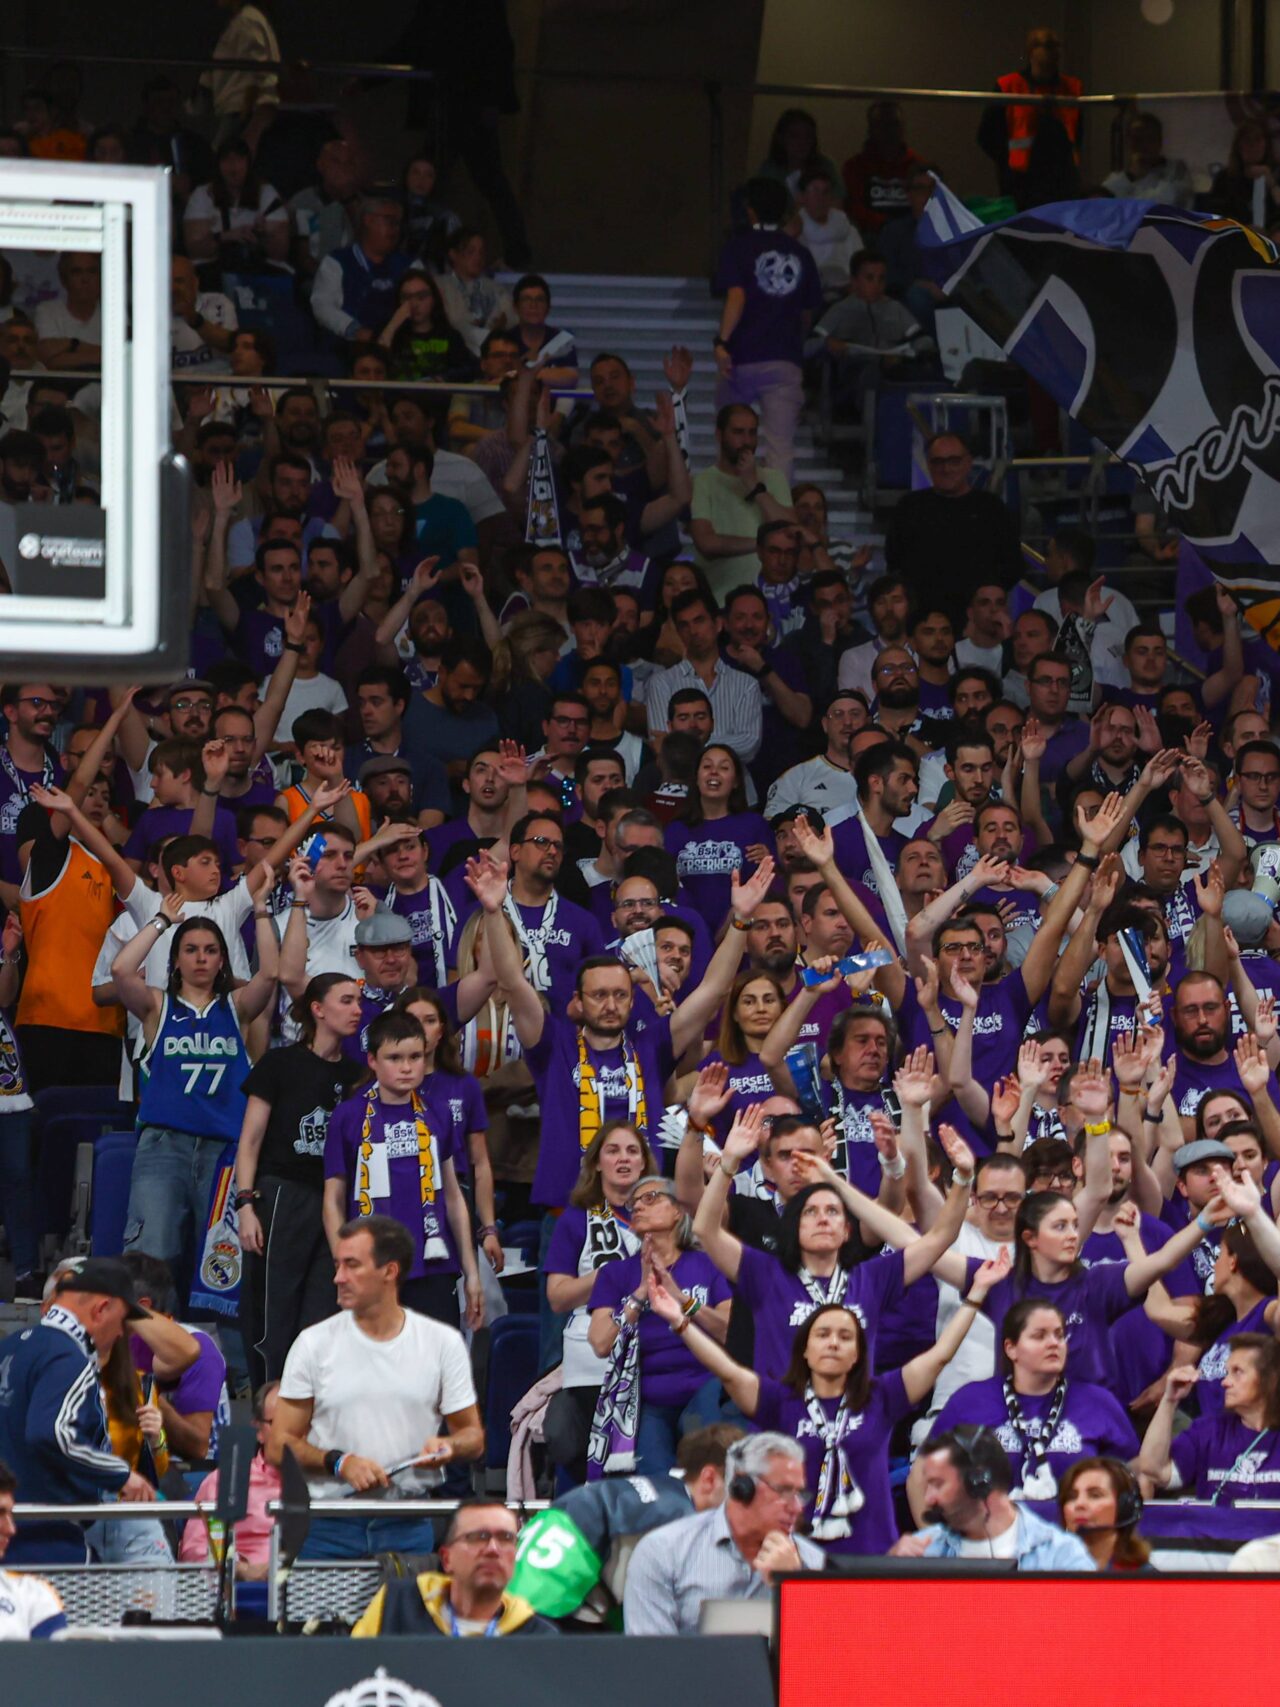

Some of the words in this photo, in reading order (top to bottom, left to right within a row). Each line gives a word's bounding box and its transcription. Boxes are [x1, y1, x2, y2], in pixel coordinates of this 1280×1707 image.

[163, 1032, 239, 1057] Dallas
[180, 1063, 227, 1096] 77
[515, 1518, 577, 1570] 15
